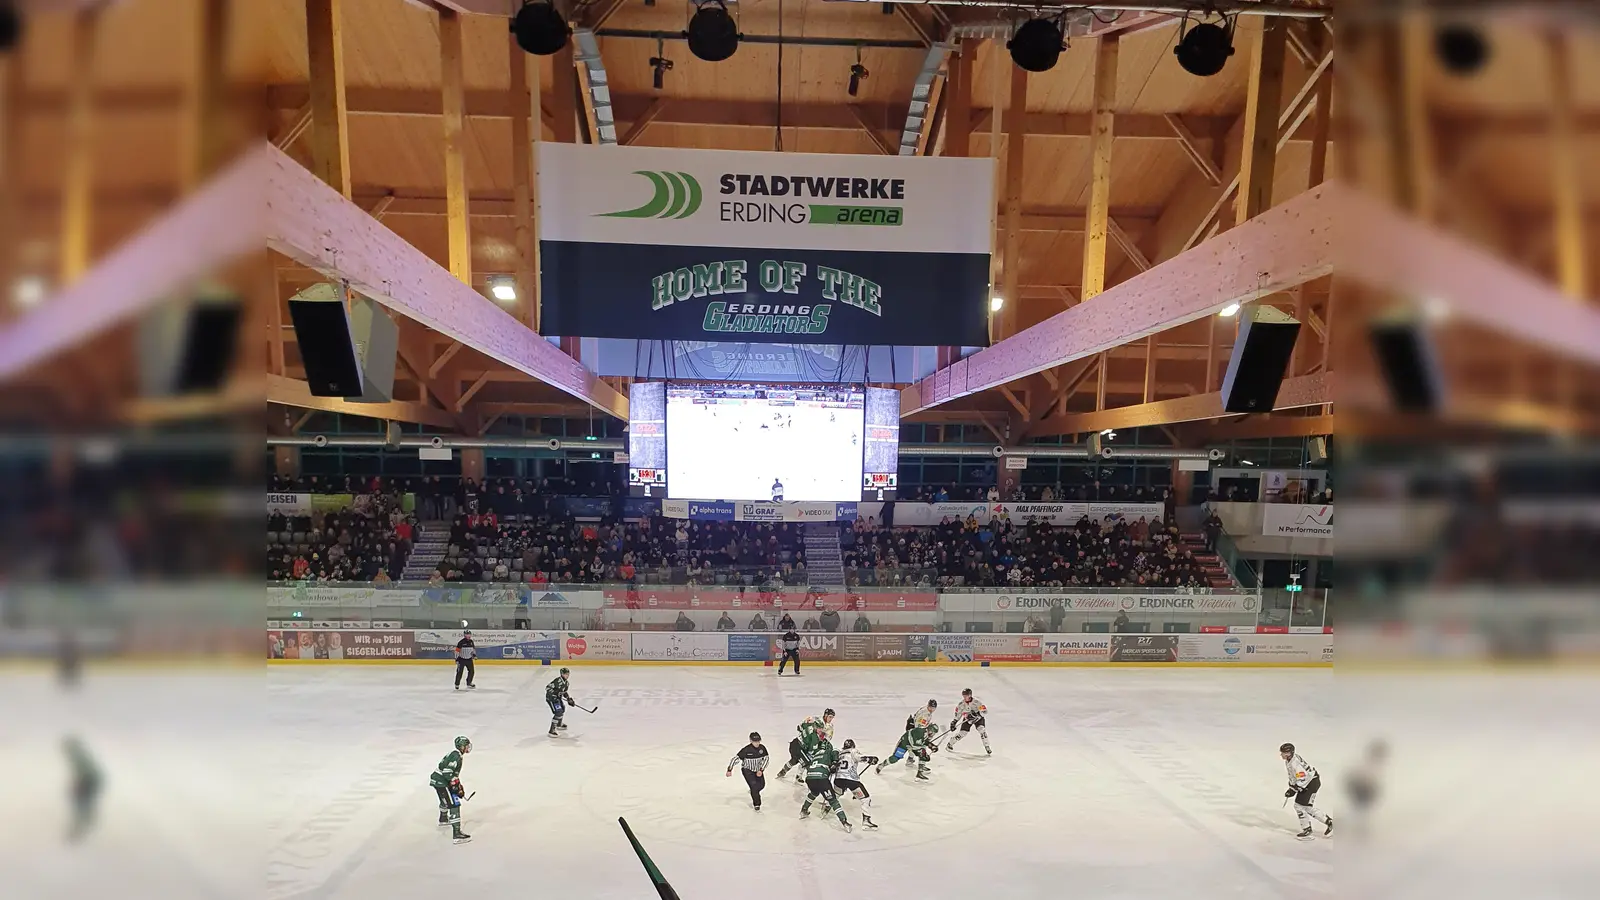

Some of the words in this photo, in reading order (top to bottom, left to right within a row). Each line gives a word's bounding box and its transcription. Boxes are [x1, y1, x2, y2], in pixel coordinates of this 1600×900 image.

[719, 173, 905, 199] STADTWERKE
[720, 202, 806, 224] ERDING
[836, 207, 900, 226] arena
[651, 259, 748, 311] HOME
[759, 259, 807, 294] OF
[816, 264, 882, 317] THE
[728, 303, 811, 315] ERDING
[702, 301, 832, 334] GLADIATORS
[699, 507, 715, 515] alpha
[1015, 505, 1030, 513] MAX
[1030, 505, 1064, 513] PFAFFINGER
[1285, 526, 1332, 534] Performance
[1139, 597, 1195, 609] ERDINGER
[354, 635, 371, 644] WIR
[383, 635, 402, 644] DEIN
[798, 636, 837, 650] AUM
[346, 645, 412, 656] SIEGERLÄCHELN
[634, 648, 664, 657] Medical
